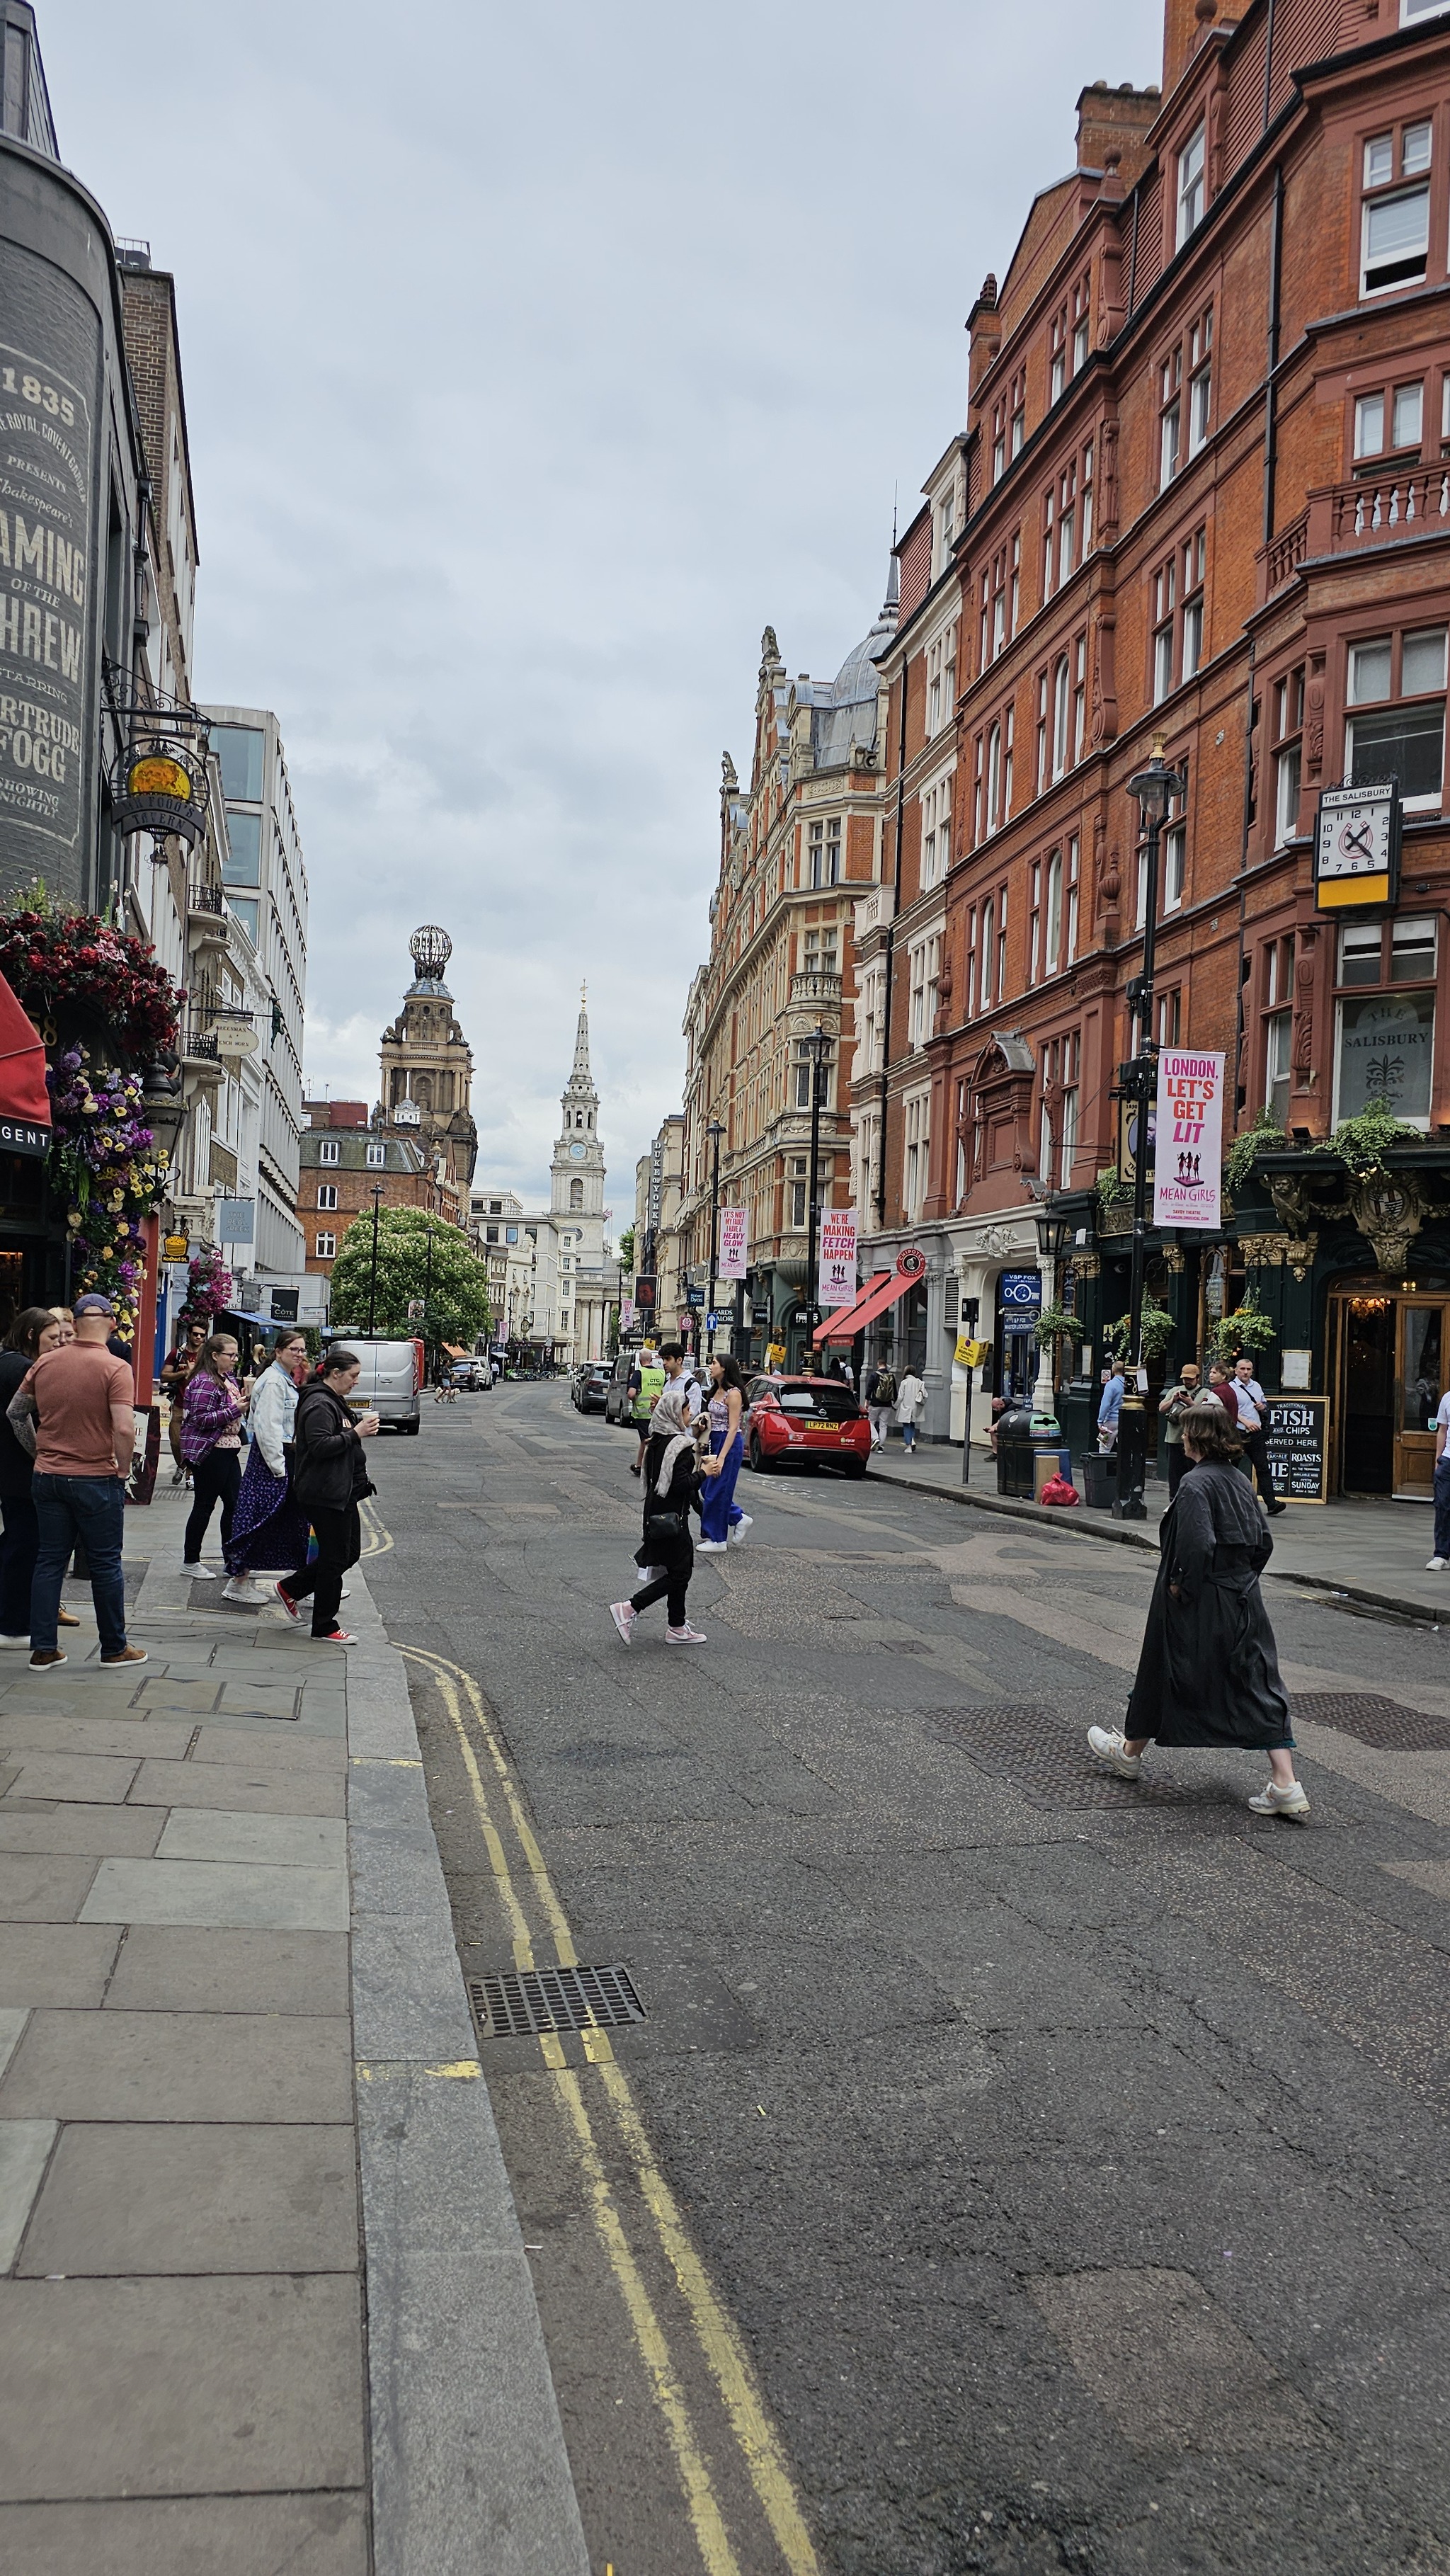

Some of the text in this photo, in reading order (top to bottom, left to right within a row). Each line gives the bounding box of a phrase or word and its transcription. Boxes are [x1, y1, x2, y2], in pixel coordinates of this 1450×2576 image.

[3, 367, 74, 426] 1835
[42, 423, 72, 462] COVENT
[69, 457, 86, 503] GARDEN
[6, 455, 67, 494] PRESENTS
[11, 578, 61, 609] OF THE
[0, 666, 68, 703] TARRING
[1324, 787, 1391, 804] THE SALISBURY
[149, 797, 195, 819] FOGG'S
[1351, 810, 1361, 819] 12
[1371, 808, 1374, 816] 1
[132, 812, 186, 831] TAVERN
[1337, 812, 1343, 821] 11
[1323, 823, 1332, 833] 10
[1335, 864, 1342, 872] 7
[1351, 862, 1358, 870] 6
[1367, 1008, 1407, 1022] THE
[1345, 1032, 1429, 1048] SALISBURY
[1164, 1057, 1218, 1081] LONDON,
[1168, 1078, 1214, 1100] LET'S
[1173, 1100, 1206, 1120] GET
[2, 1126, 48, 1146] GENT
[1172, 1122, 1205, 1144] LIT
[1160, 1187, 1216, 1202] MEAN GIRLS
[651, 1185, 660, 1228] YORK'S
[830, 1213, 849, 1225] WE'RE
[823, 1225, 855, 1237] MAKING
[823, 1237, 855, 1249] FETCH
[823, 1248, 854, 1261] HAPPEN
[899, 1249, 925, 1261] CHIPOTLE
[838, 1284, 854, 1293] GIRLS
[959, 1349, 974, 1358] WARNING
[1269, 1410, 1314, 1425] FISH
[1286, 1426, 1311, 1435] CHIPS
[1291, 1453, 1321, 1462] ROASTS
